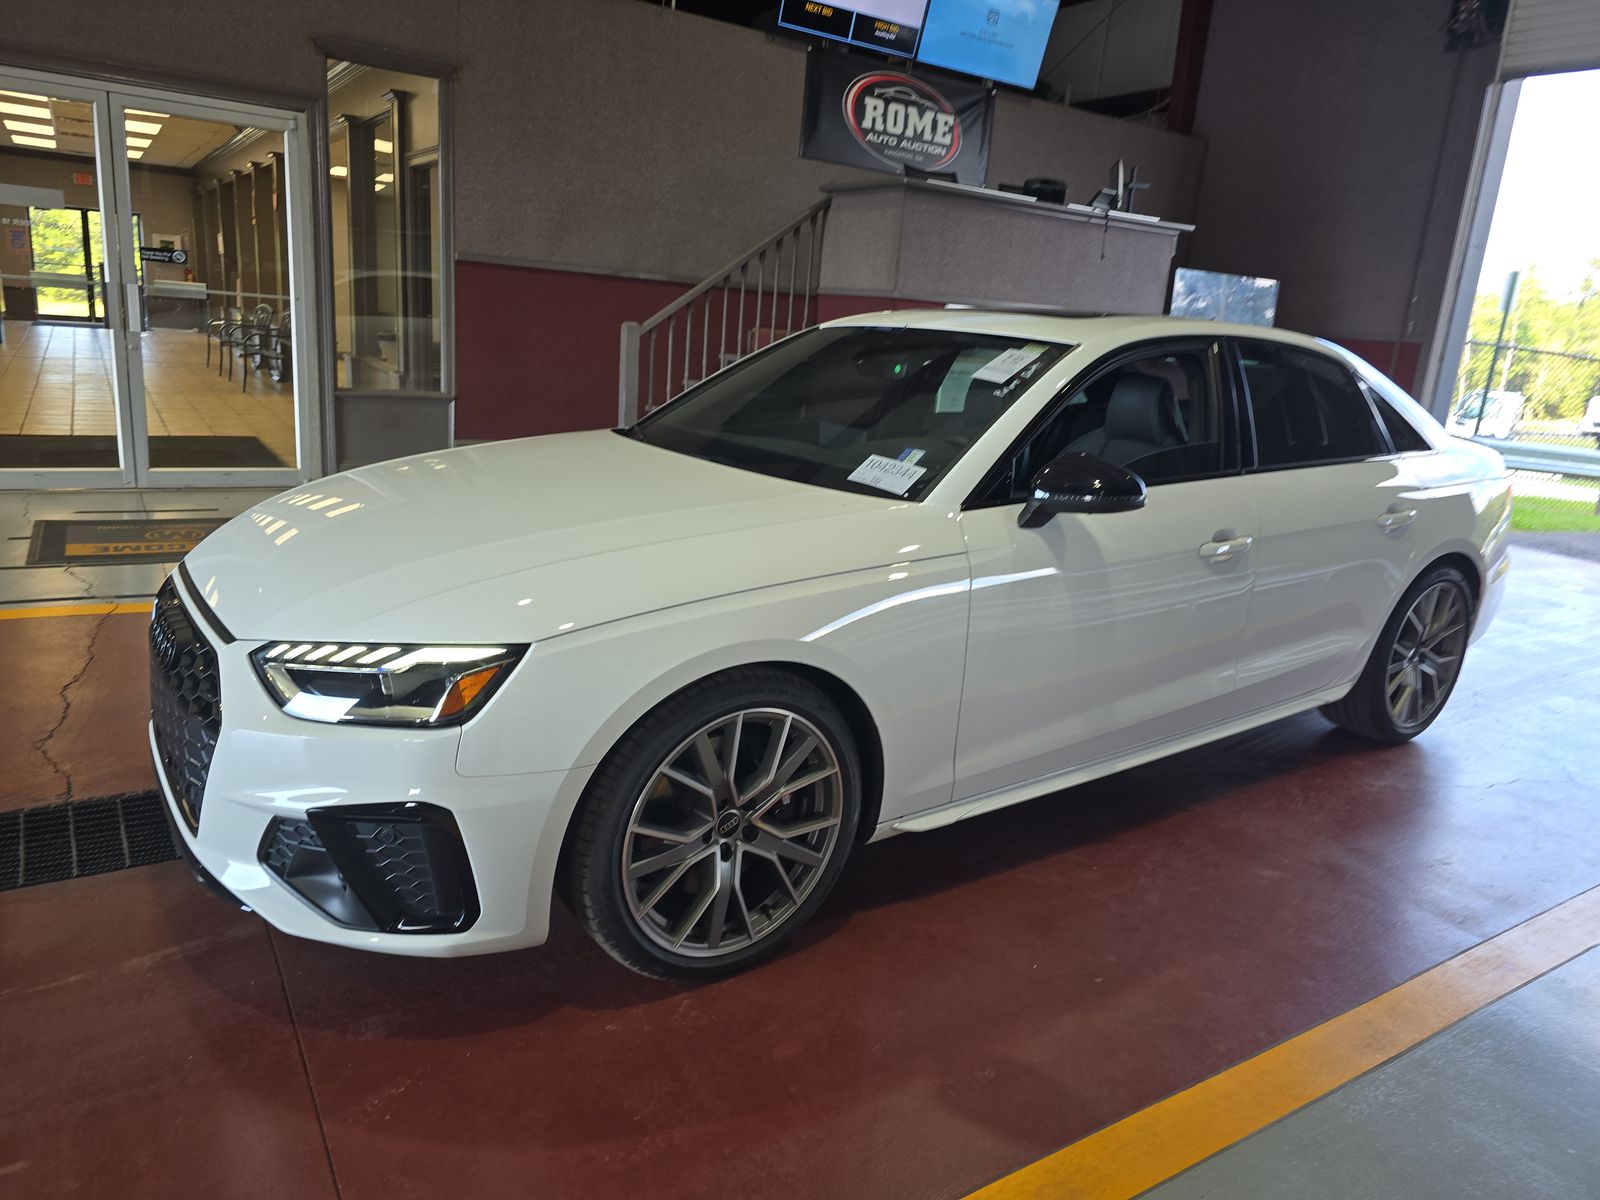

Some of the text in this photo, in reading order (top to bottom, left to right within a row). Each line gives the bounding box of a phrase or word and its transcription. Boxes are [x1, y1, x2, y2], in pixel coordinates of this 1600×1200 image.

[804, 1, 834, 17] NEXT BID
[874, 20, 900, 34] HIGH BID
[861, 95, 955, 146] ROME
[865, 131, 898, 146] AUTO
[899, 138, 947, 156] AUCTION
